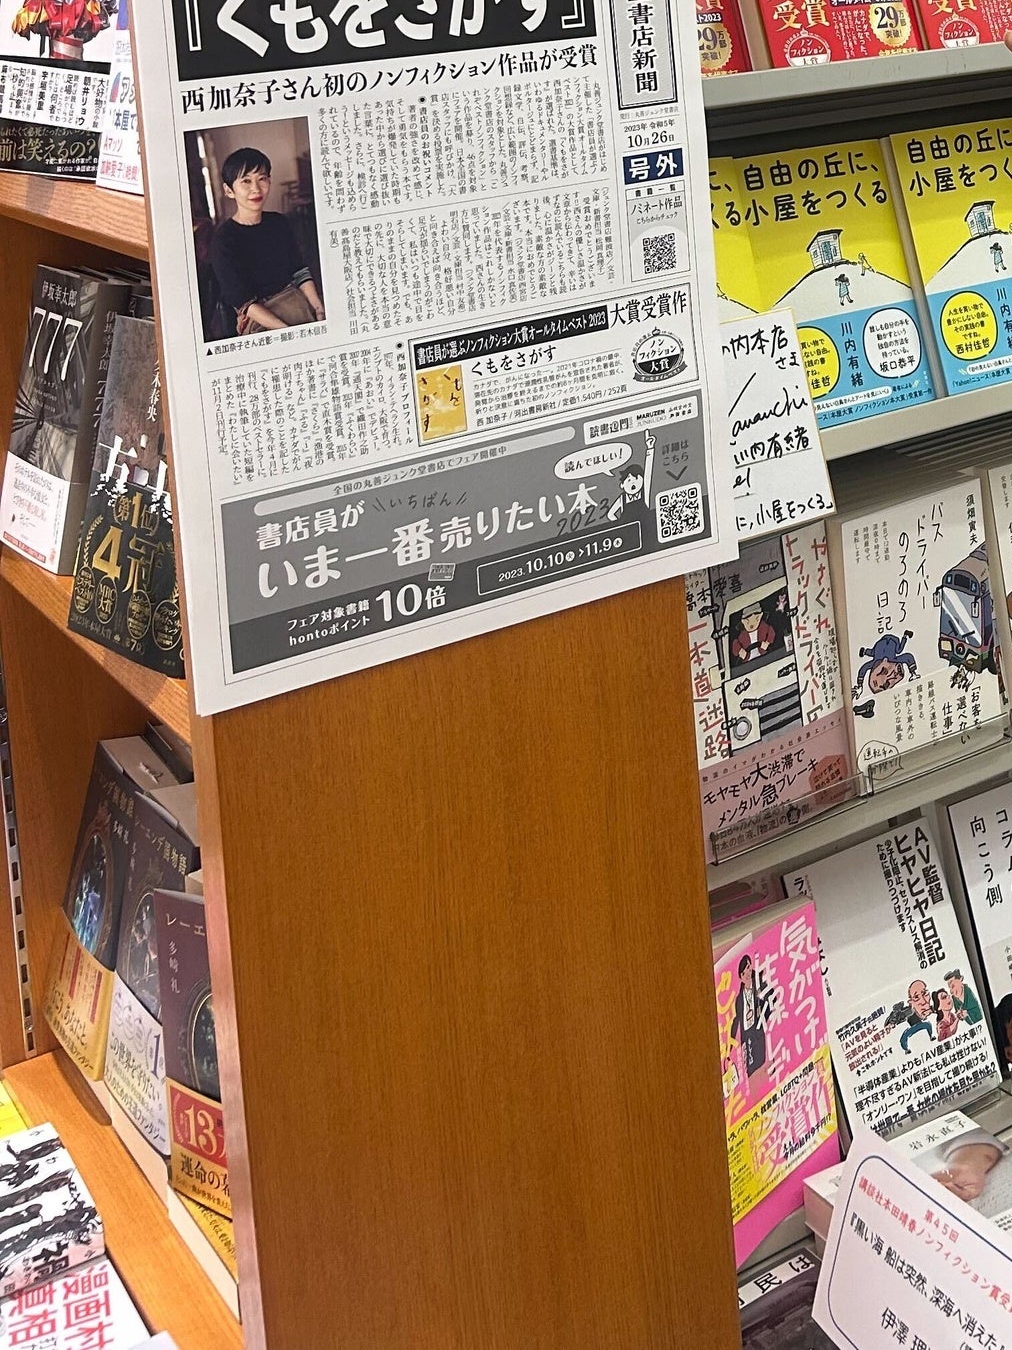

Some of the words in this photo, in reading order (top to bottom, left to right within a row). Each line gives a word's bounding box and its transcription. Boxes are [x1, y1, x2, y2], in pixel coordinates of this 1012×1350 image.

[181, 44, 598, 113] 西加奈子さん初のノンフィクション作品が受賞
[624, 123, 648, 133] 2023年
[627, 132, 676, 148] 10月26日
[628, 156, 678, 181] 号外
[743, 151, 878, 192] 自由の丘に、
[631, 198, 683, 215] ノミネート作品
[744, 180, 888, 228] 小屋をつくる
[41, 280, 79, 306] 伊坂幸太郎
[610, 290, 688, 326] 大賞受賞作
[27, 306, 83, 382] 777
[471, 345, 558, 377] くもをさがす
[775, 351, 800, 370] さま
[841, 321, 864, 388] 川内有緒
[955, 339, 990, 356] 西村佳哲
[879, 356, 916, 373] 坂口恭平
[333, 444, 508, 495] 全国の丸善ジュンク堂書店でフェア開催中
[564, 448, 624, 473] 読んでほしい!
[385, 492, 452, 509] いちばん
[256, 484, 598, 598] いま一番売りたい本
[257, 499, 365, 550] 書店員が
[930, 502, 944, 543] バス
[897, 531, 910, 625] のろのろ
[915, 516, 929, 610] ドライバー
[287, 600, 370, 631] フェア対象書籍
[376, 586, 447, 623] 10倍
[876, 592, 893, 632] 日記
[289, 615, 371, 646] hontoポイント
[703, 748, 805, 805] モヤモヤ大渋滞で
[717, 759, 819, 827] メンタル急ブレーキ
[913, 827, 945, 905] AV監督
[969, 816, 1003, 908] 向こう側
[894, 836, 946, 965] ヒヤヒヤ日記
[922, 1208, 961, 1244] 第45回
